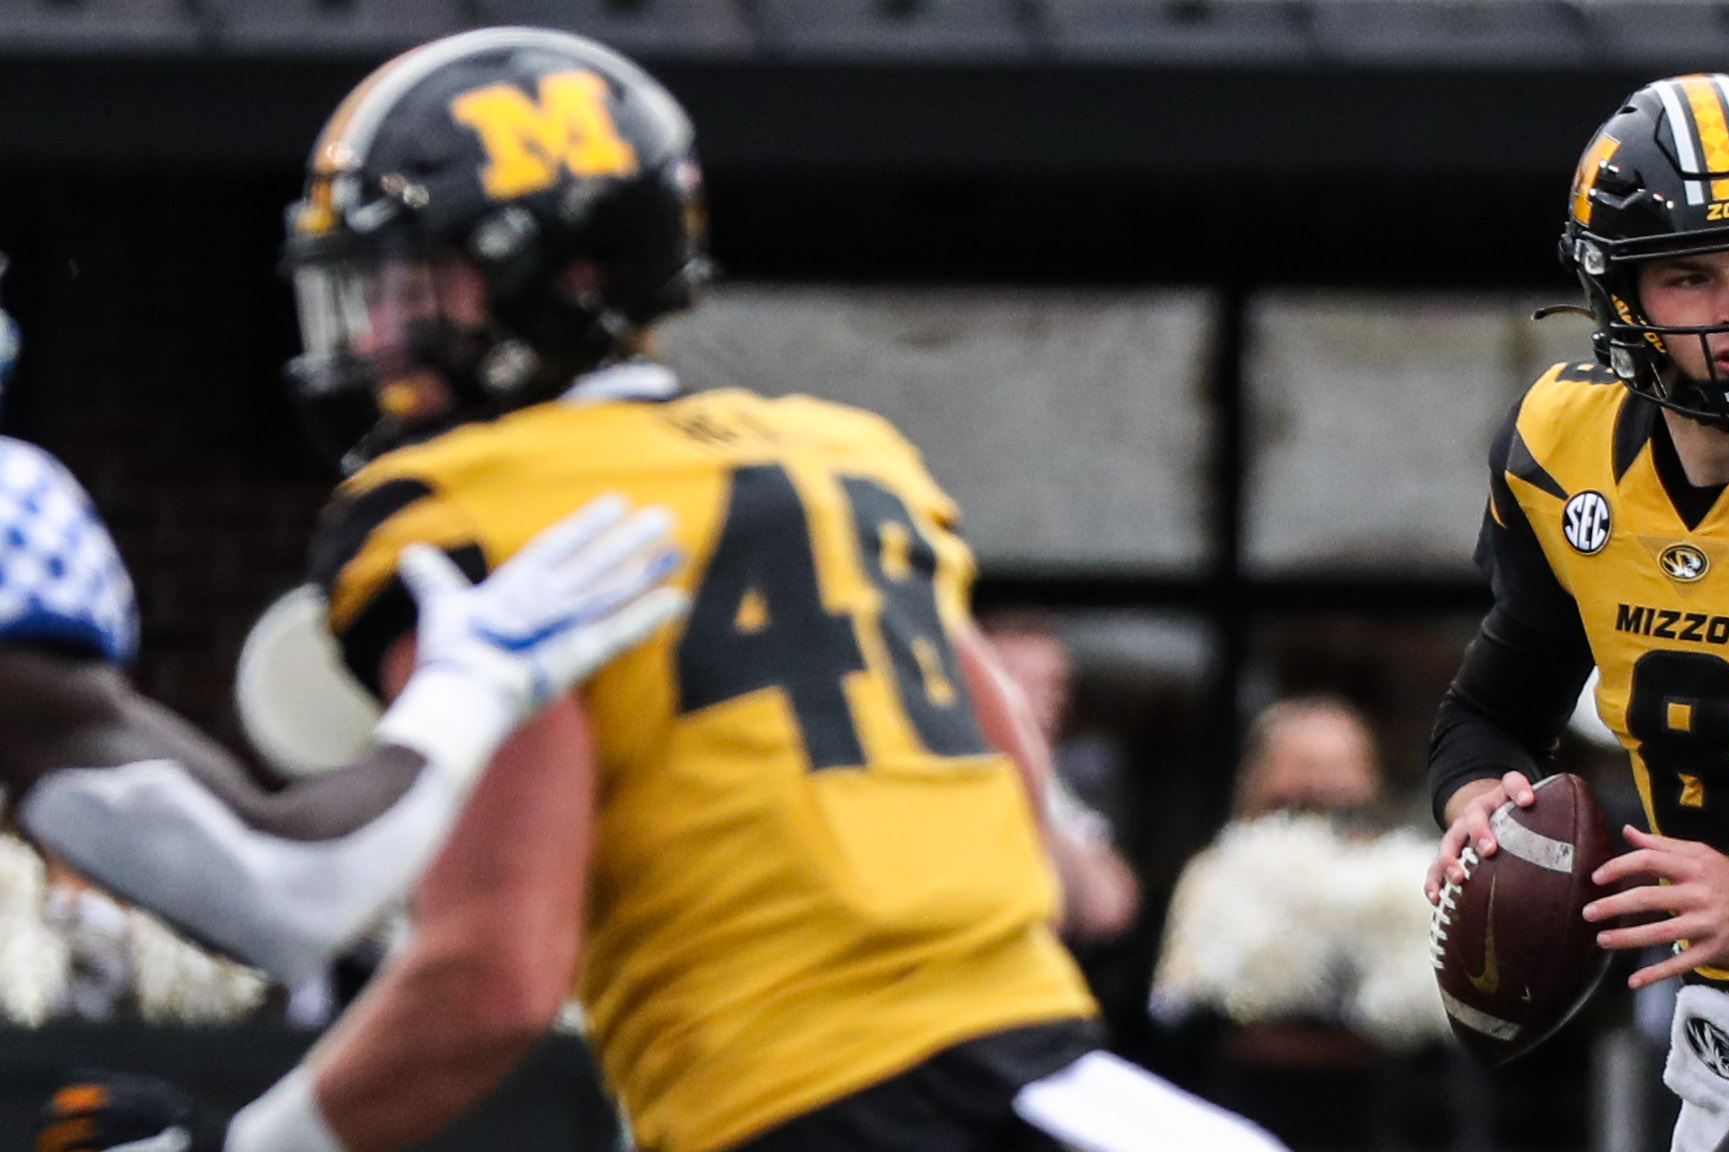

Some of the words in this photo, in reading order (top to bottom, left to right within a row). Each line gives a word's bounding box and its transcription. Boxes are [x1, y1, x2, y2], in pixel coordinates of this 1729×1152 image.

[450, 68, 640, 199] M
[1564, 492, 1609, 551] SEC
[673, 460, 990, 775] 48
